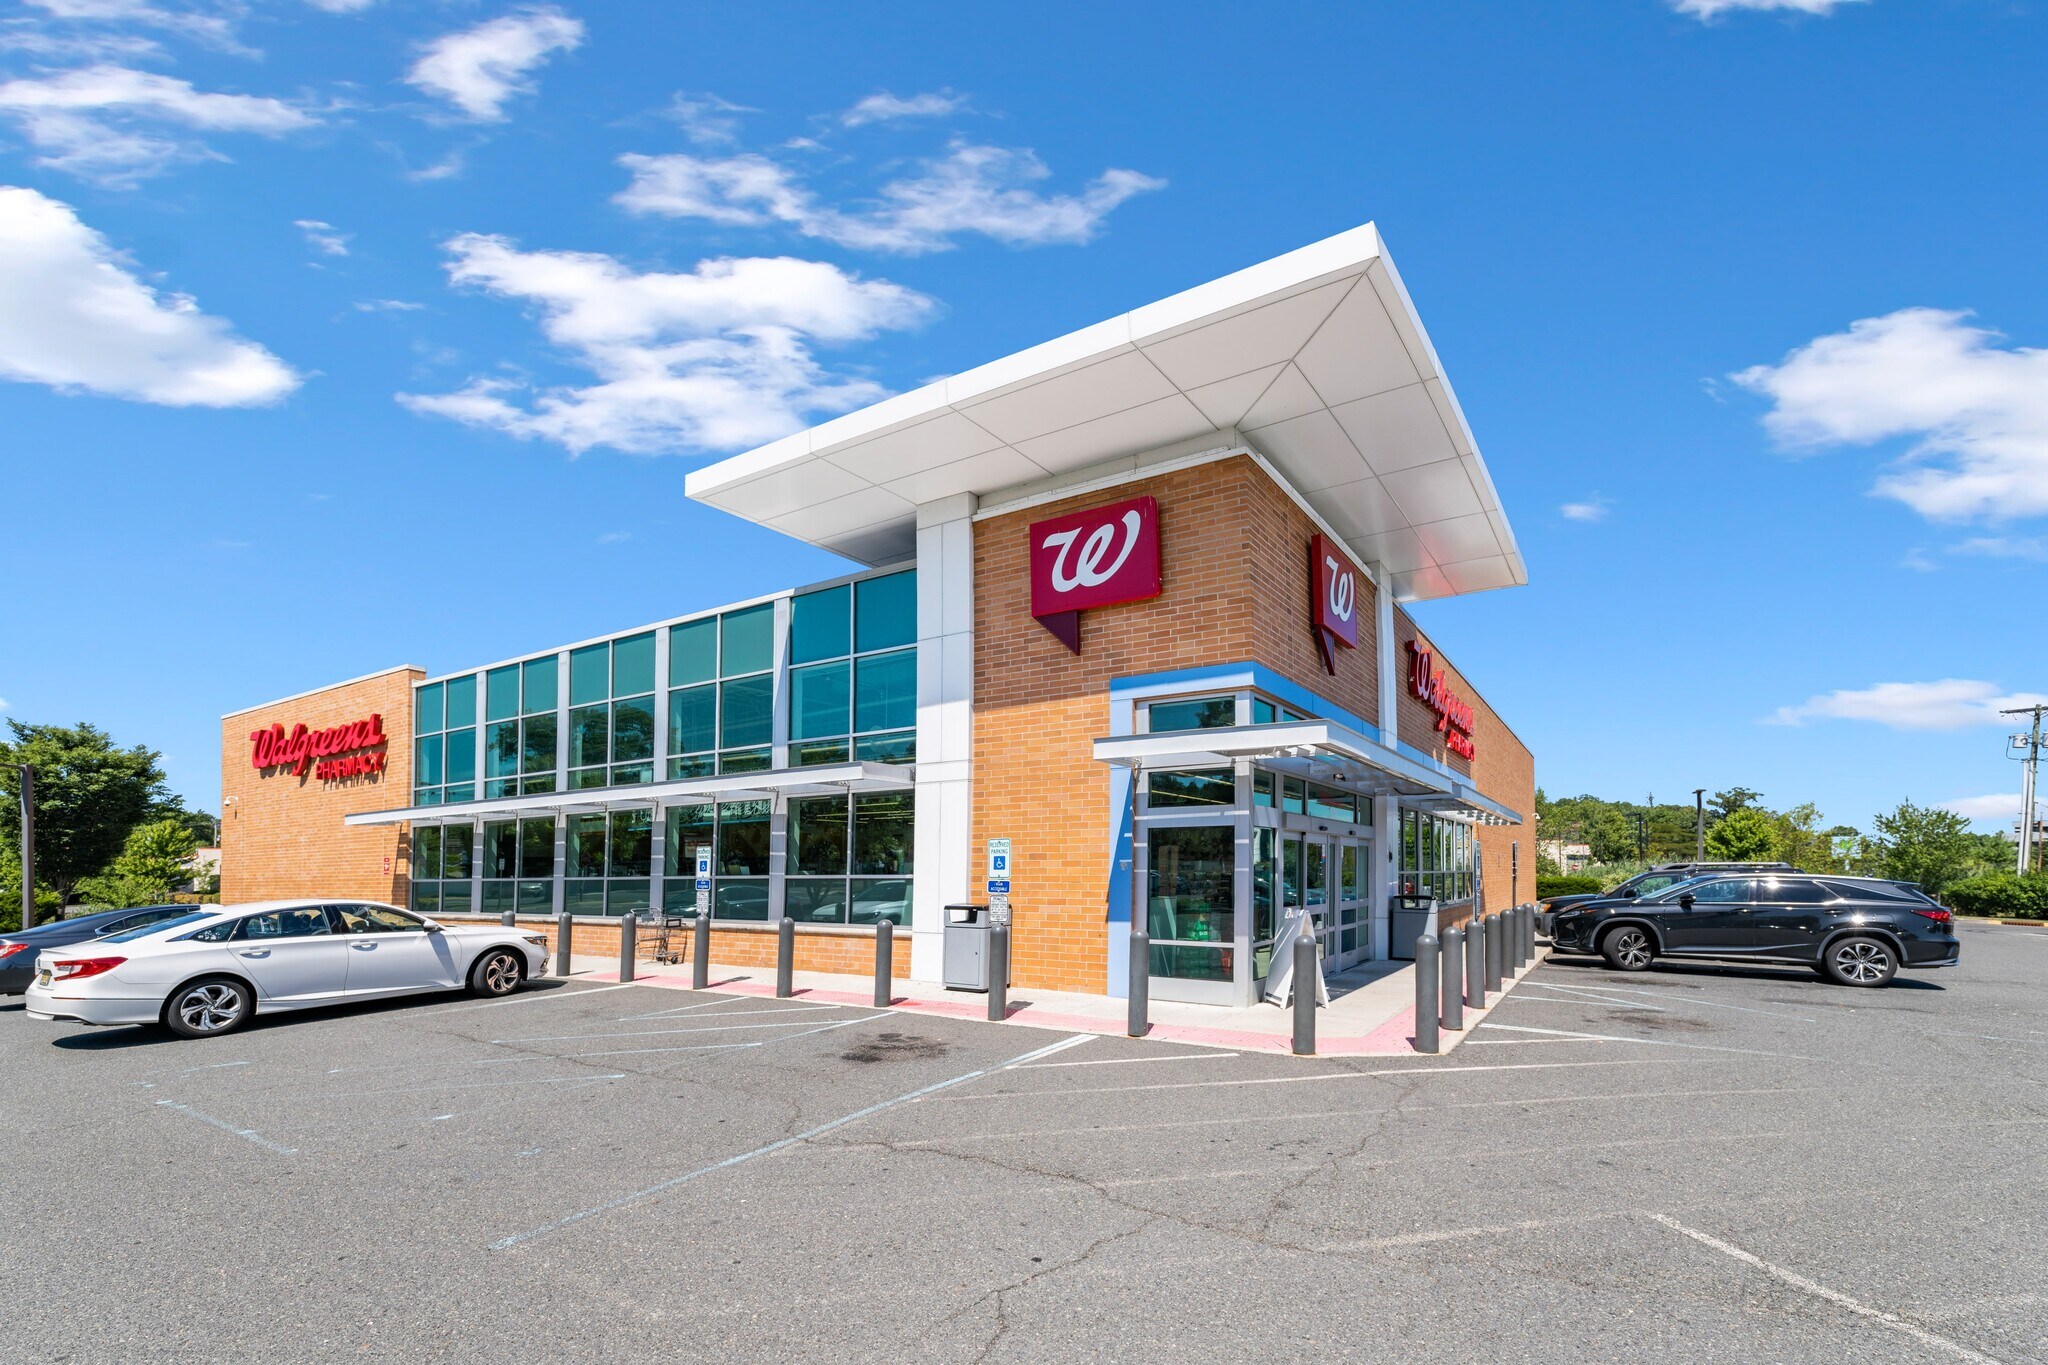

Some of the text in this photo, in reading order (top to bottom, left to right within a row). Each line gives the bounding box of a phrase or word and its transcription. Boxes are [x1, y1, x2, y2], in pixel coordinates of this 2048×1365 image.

[1042, 510, 1141, 593] W
[1325, 555, 1355, 622] W
[1405, 640, 1475, 737] Walgreens
[250, 713, 387, 776] Walgreens
[315, 752, 386, 780] PHARMACY
